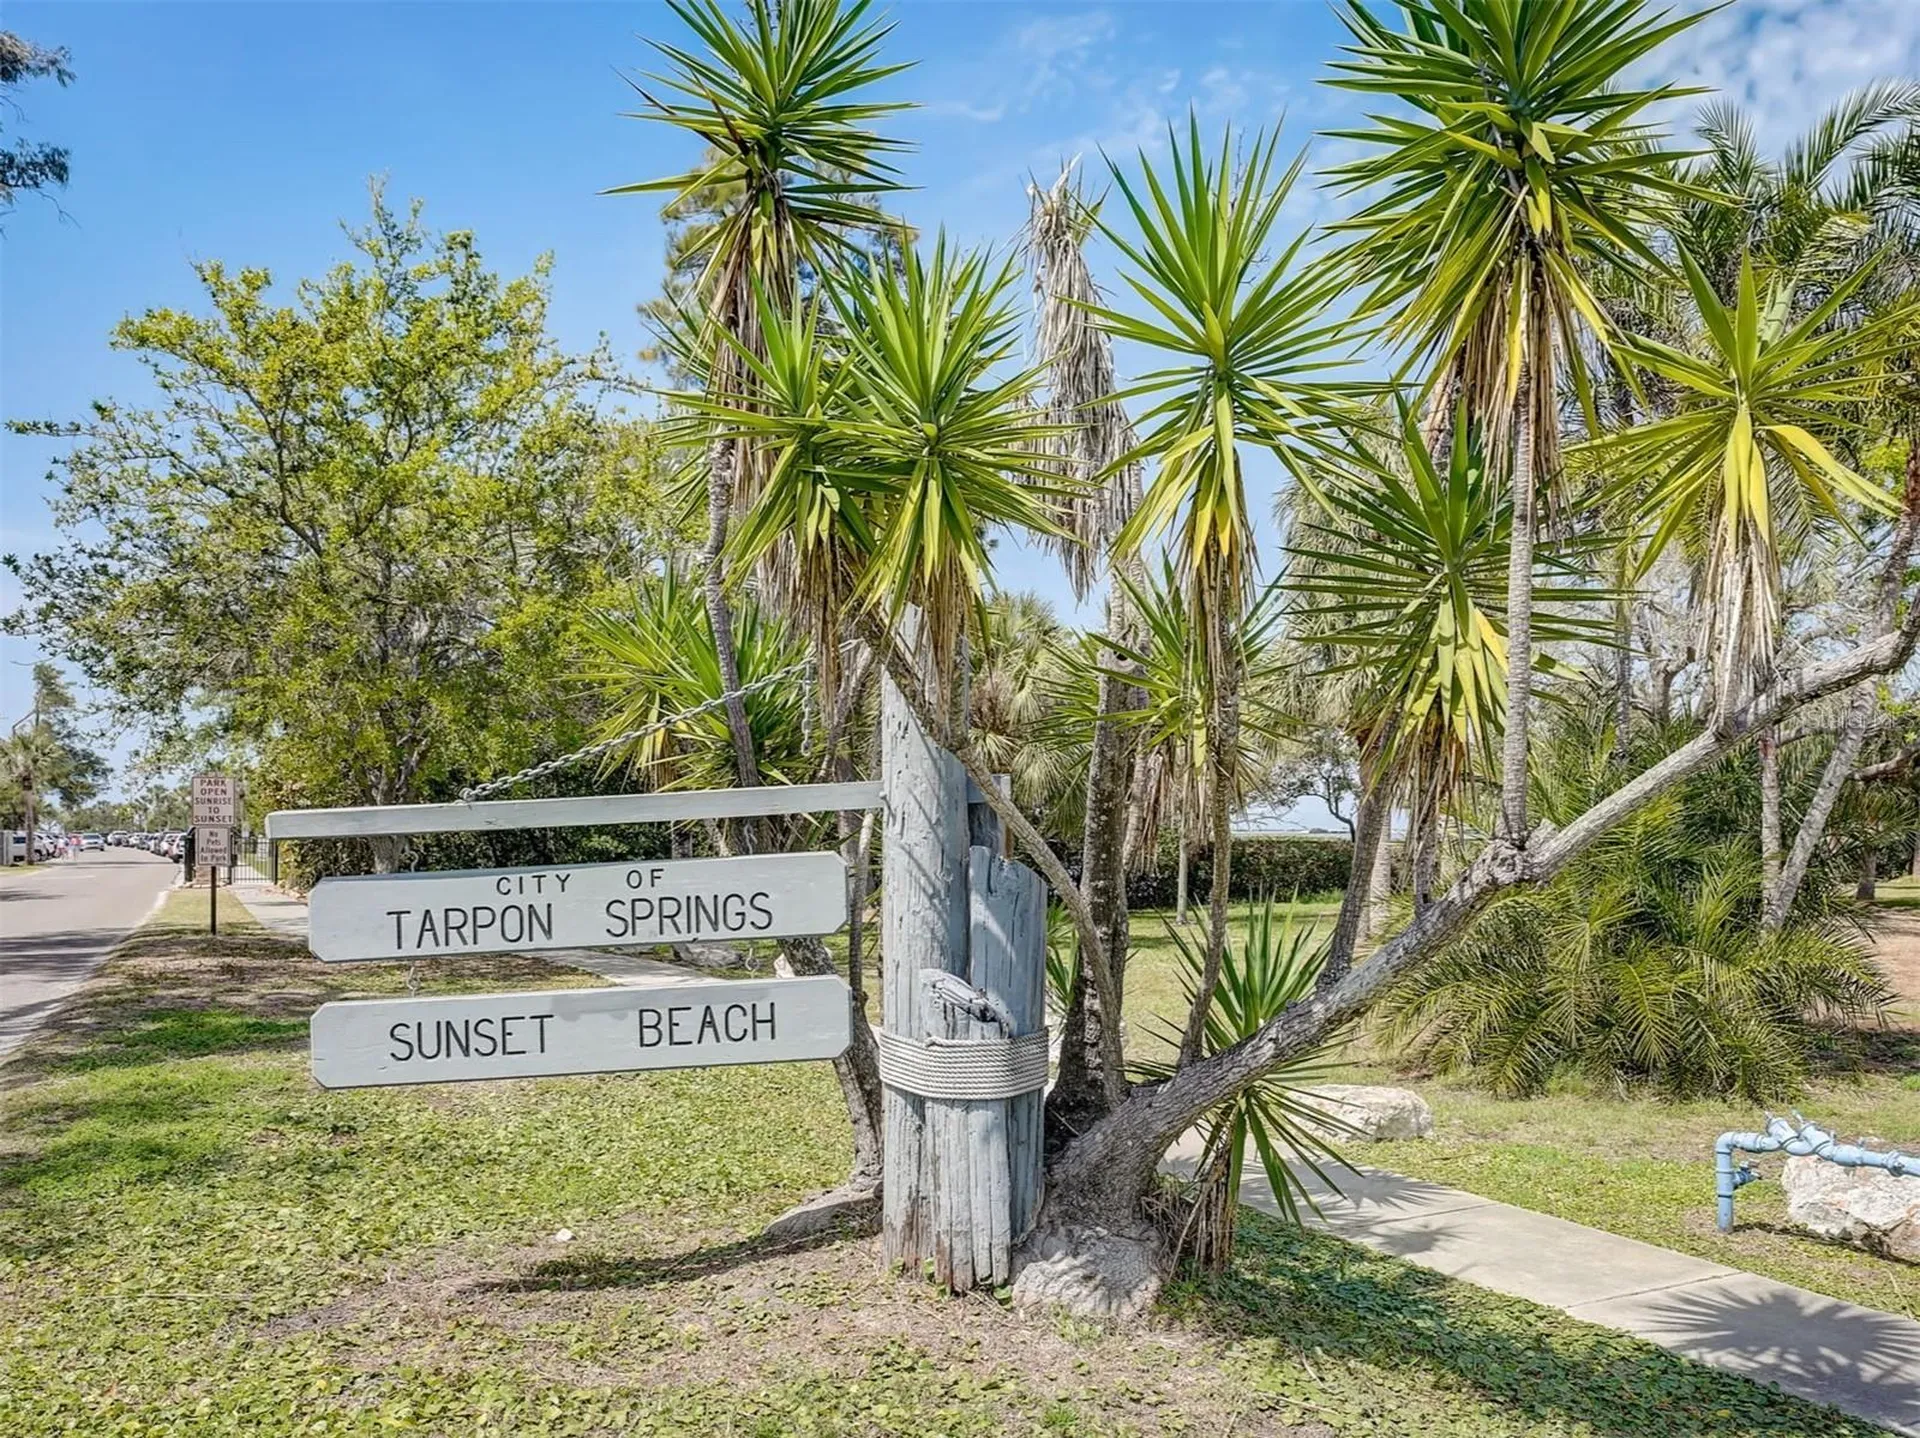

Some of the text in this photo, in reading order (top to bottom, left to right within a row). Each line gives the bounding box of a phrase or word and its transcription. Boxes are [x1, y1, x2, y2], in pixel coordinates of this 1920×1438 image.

[194, 798, 232, 806] SUNRISE
[194, 816, 232, 824] SUNSET
[496, 868, 664, 896] CITY OF
[387, 891, 774, 950] TARPON SPRINGS
[389, 1002, 776, 1062] SUNSET BEACH
